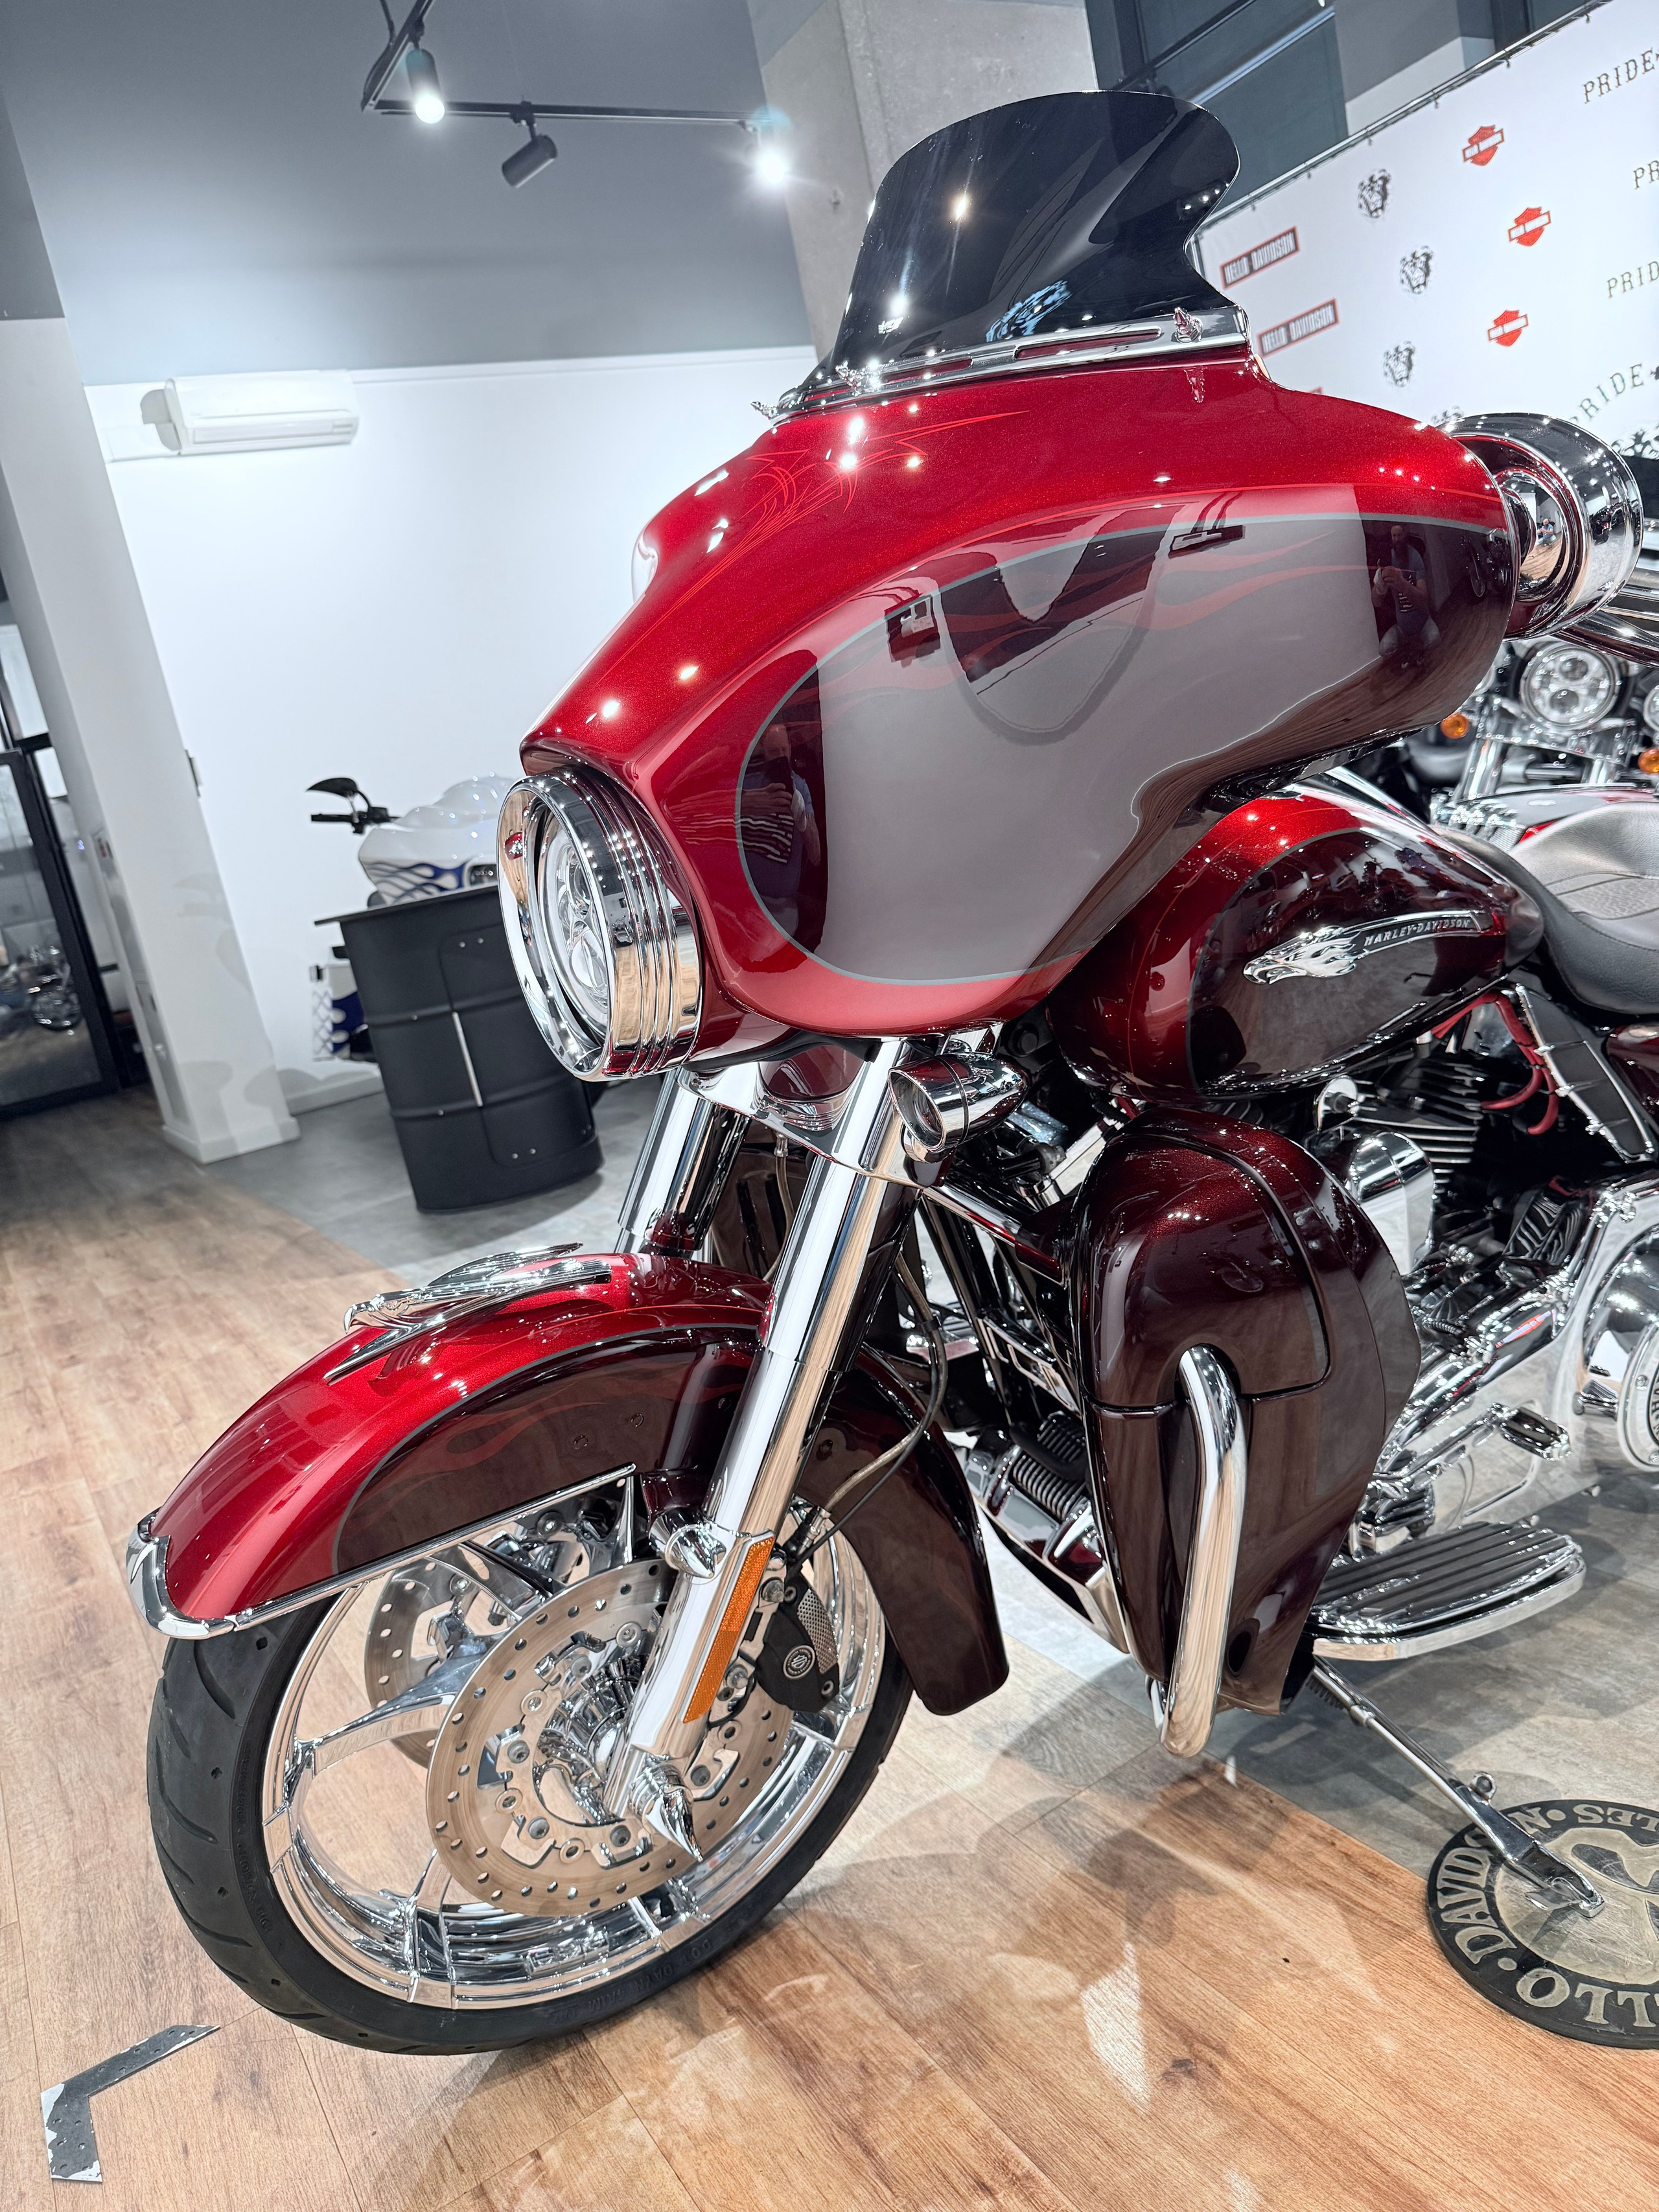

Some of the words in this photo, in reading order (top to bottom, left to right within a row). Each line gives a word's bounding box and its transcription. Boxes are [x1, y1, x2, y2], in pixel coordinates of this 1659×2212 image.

[1582, 47, 1655, 104] PRIDE
[1251, 230, 1297, 271] DAVIDSON
[1289, 303, 1336, 342] DAVIDSON
[1363, 919, 1471, 947] HARLEY-DAVIDSON
